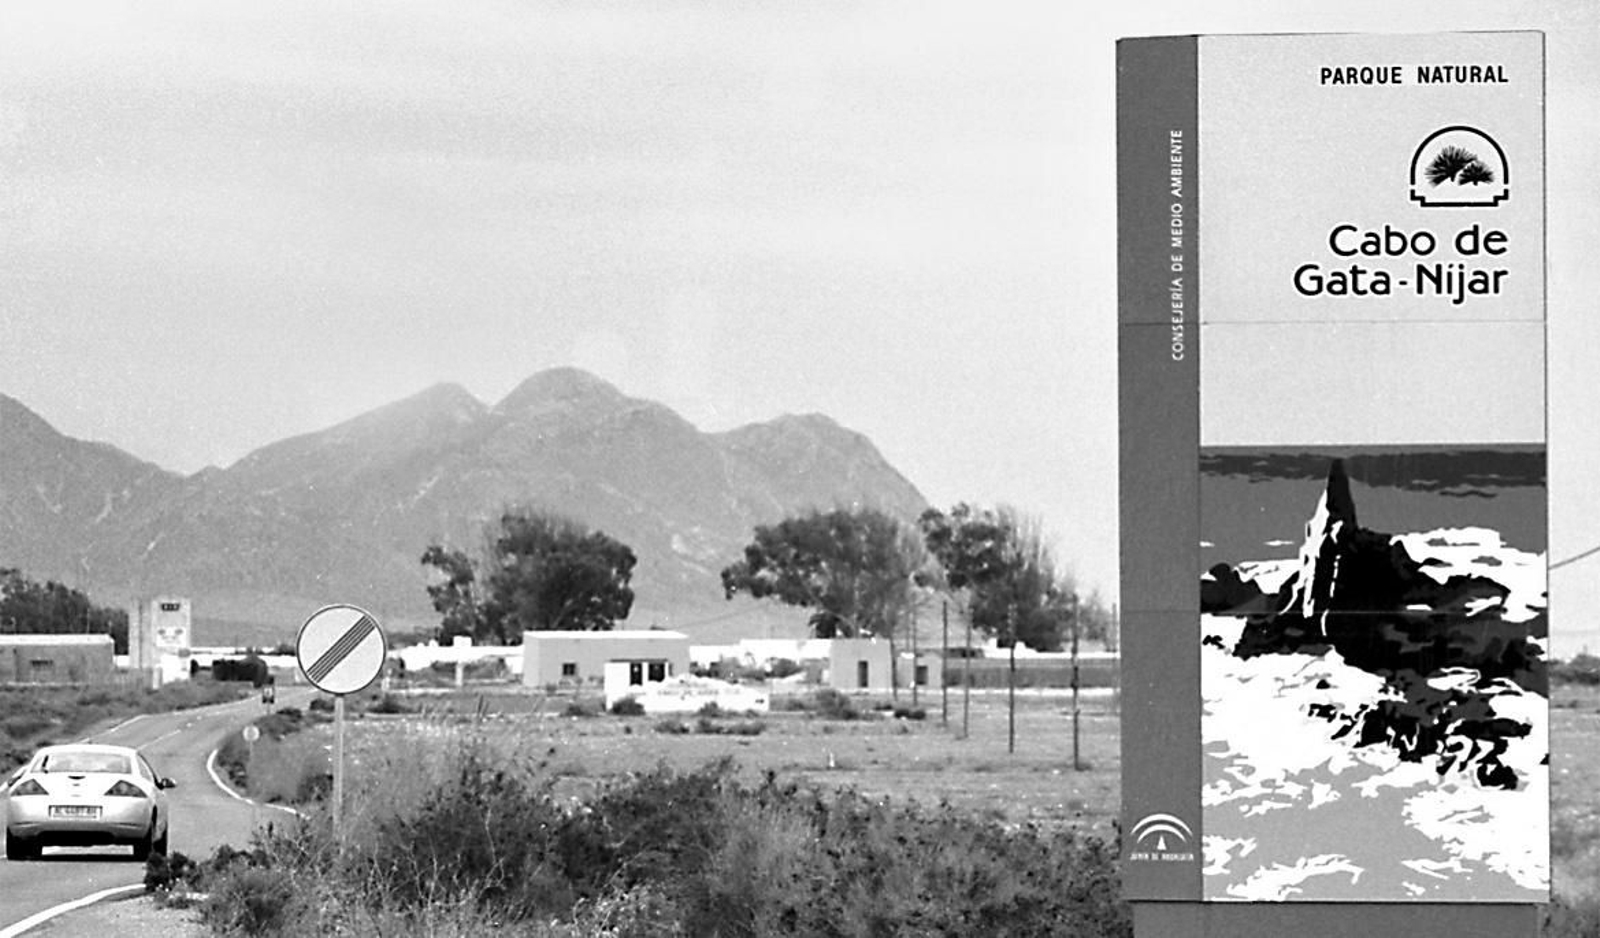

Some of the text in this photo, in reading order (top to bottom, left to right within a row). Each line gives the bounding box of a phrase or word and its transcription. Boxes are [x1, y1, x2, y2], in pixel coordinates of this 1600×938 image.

[1321, 66, 1508, 84] PARQUE NATURAL
[1170, 131, 1184, 360] CONSEJERÍA DE MEDIO AMBIENTE
[1330, 225, 1507, 256] Cabo de
